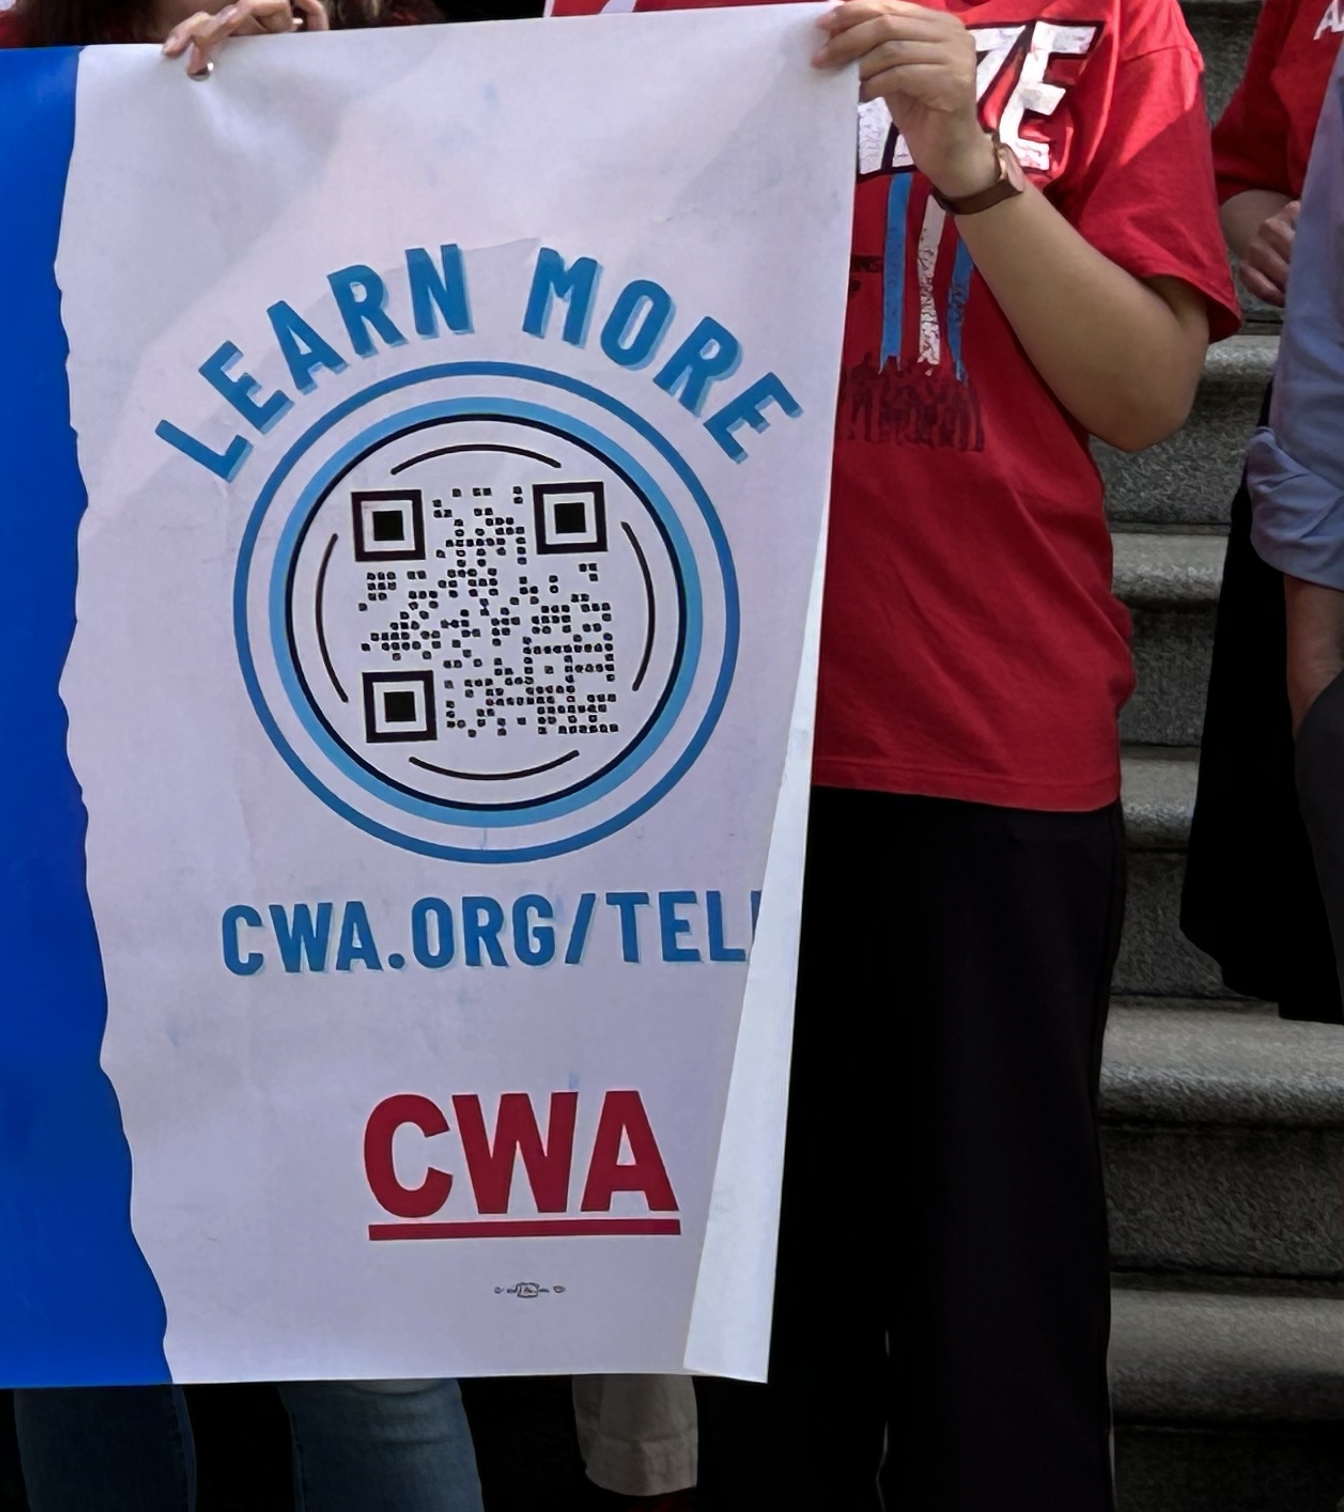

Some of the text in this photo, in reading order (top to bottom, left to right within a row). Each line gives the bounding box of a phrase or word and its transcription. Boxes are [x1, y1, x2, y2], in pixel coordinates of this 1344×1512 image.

[155, 243, 804, 483] LEARN MORE
[363, 1089, 681, 1219] CWA
